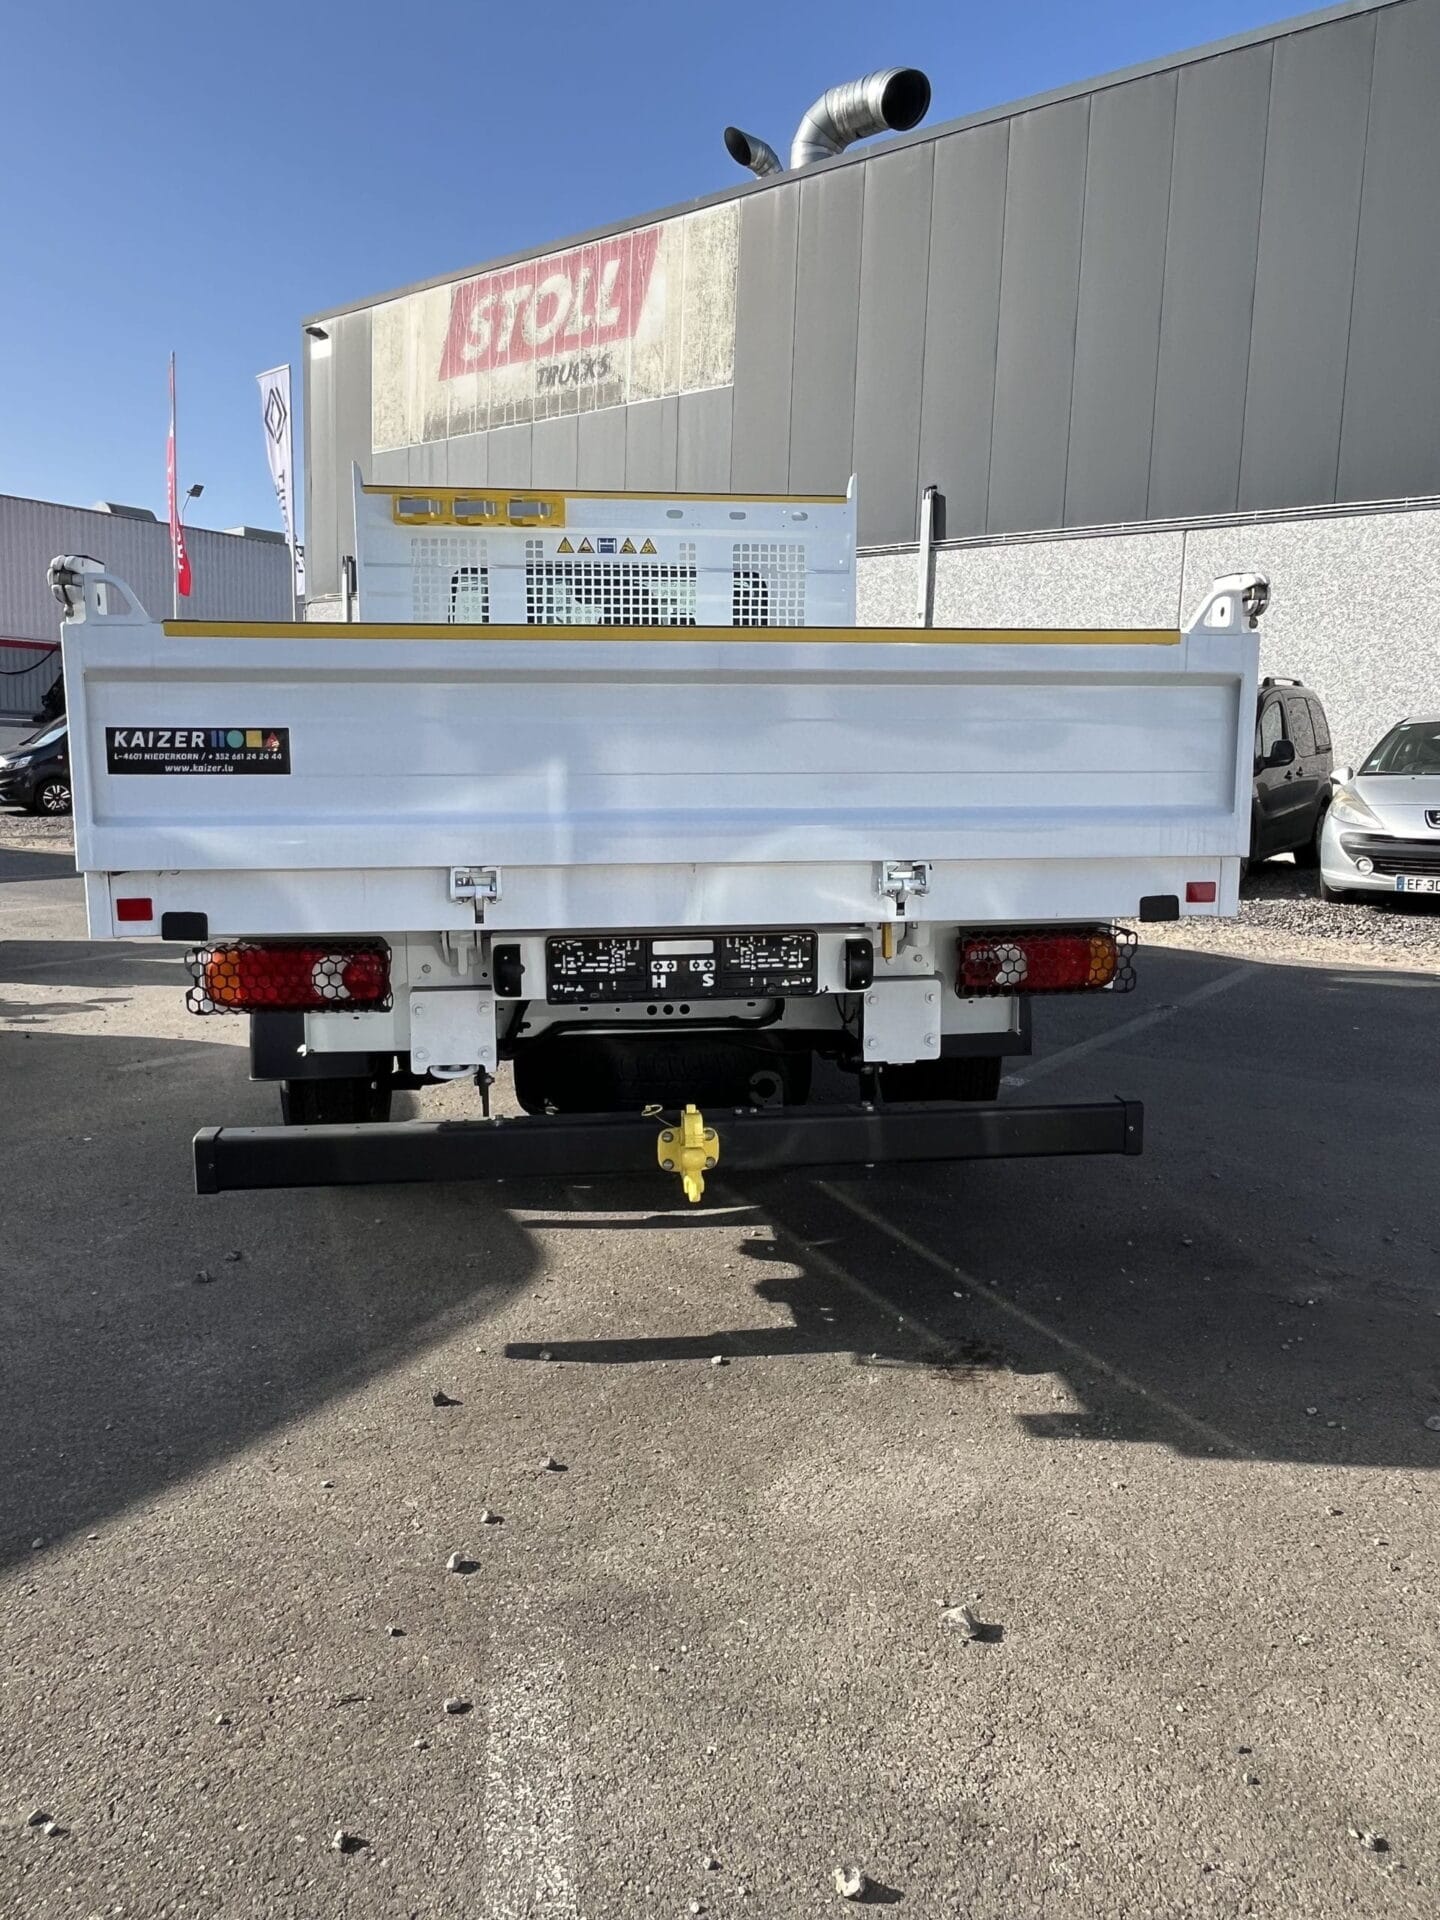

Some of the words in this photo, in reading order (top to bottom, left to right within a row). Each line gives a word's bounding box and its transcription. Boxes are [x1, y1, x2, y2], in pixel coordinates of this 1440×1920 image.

[460, 259, 623, 362] STOLL
[536, 352, 611, 386] TRUCKS
[114, 730, 205, 748] KAIZER
[144, 752, 199, 760] NIEDERKORN
[164, 763, 234, 773] www.kaizer.lu
[652, 974, 667, 989] H
[702, 973, 715, 988] S
